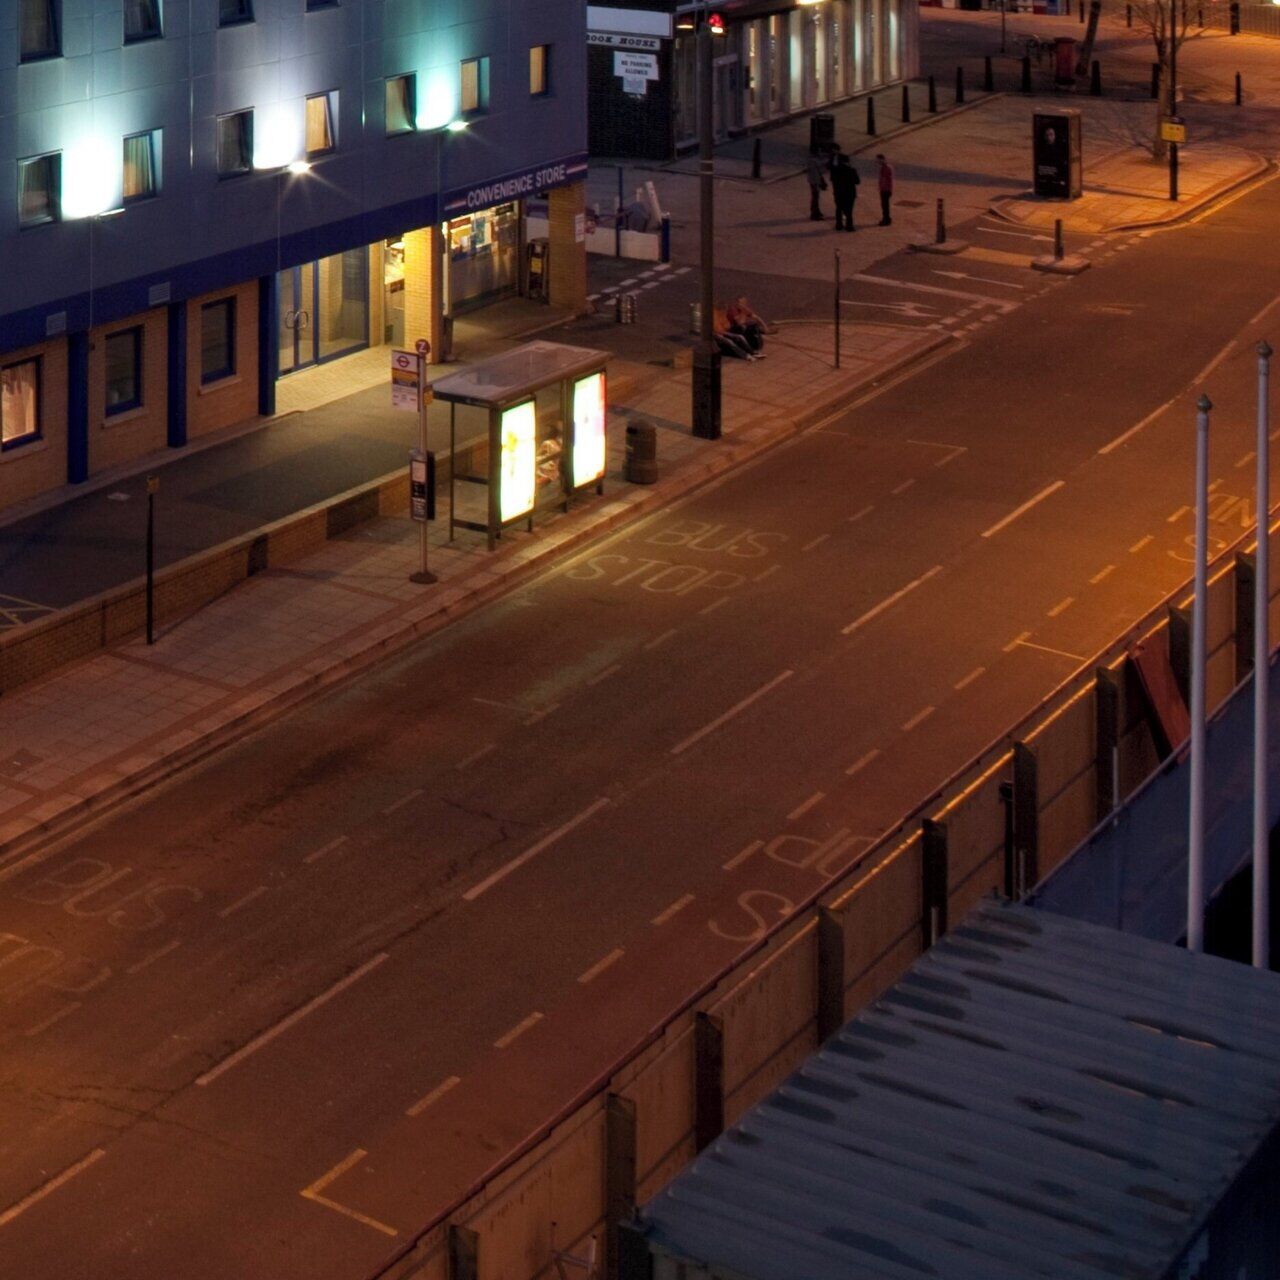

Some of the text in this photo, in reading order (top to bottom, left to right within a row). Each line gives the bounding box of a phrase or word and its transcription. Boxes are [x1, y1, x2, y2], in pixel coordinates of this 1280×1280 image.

[618, 37, 657, 48] HOUSE
[467, 164, 566, 208] CONVENIENCE STORE
[418, 341, 427, 353] Z
[644, 521, 789, 558] BUS
[565, 554, 747, 596] STOP
[12, 858, 204, 931] BUS
